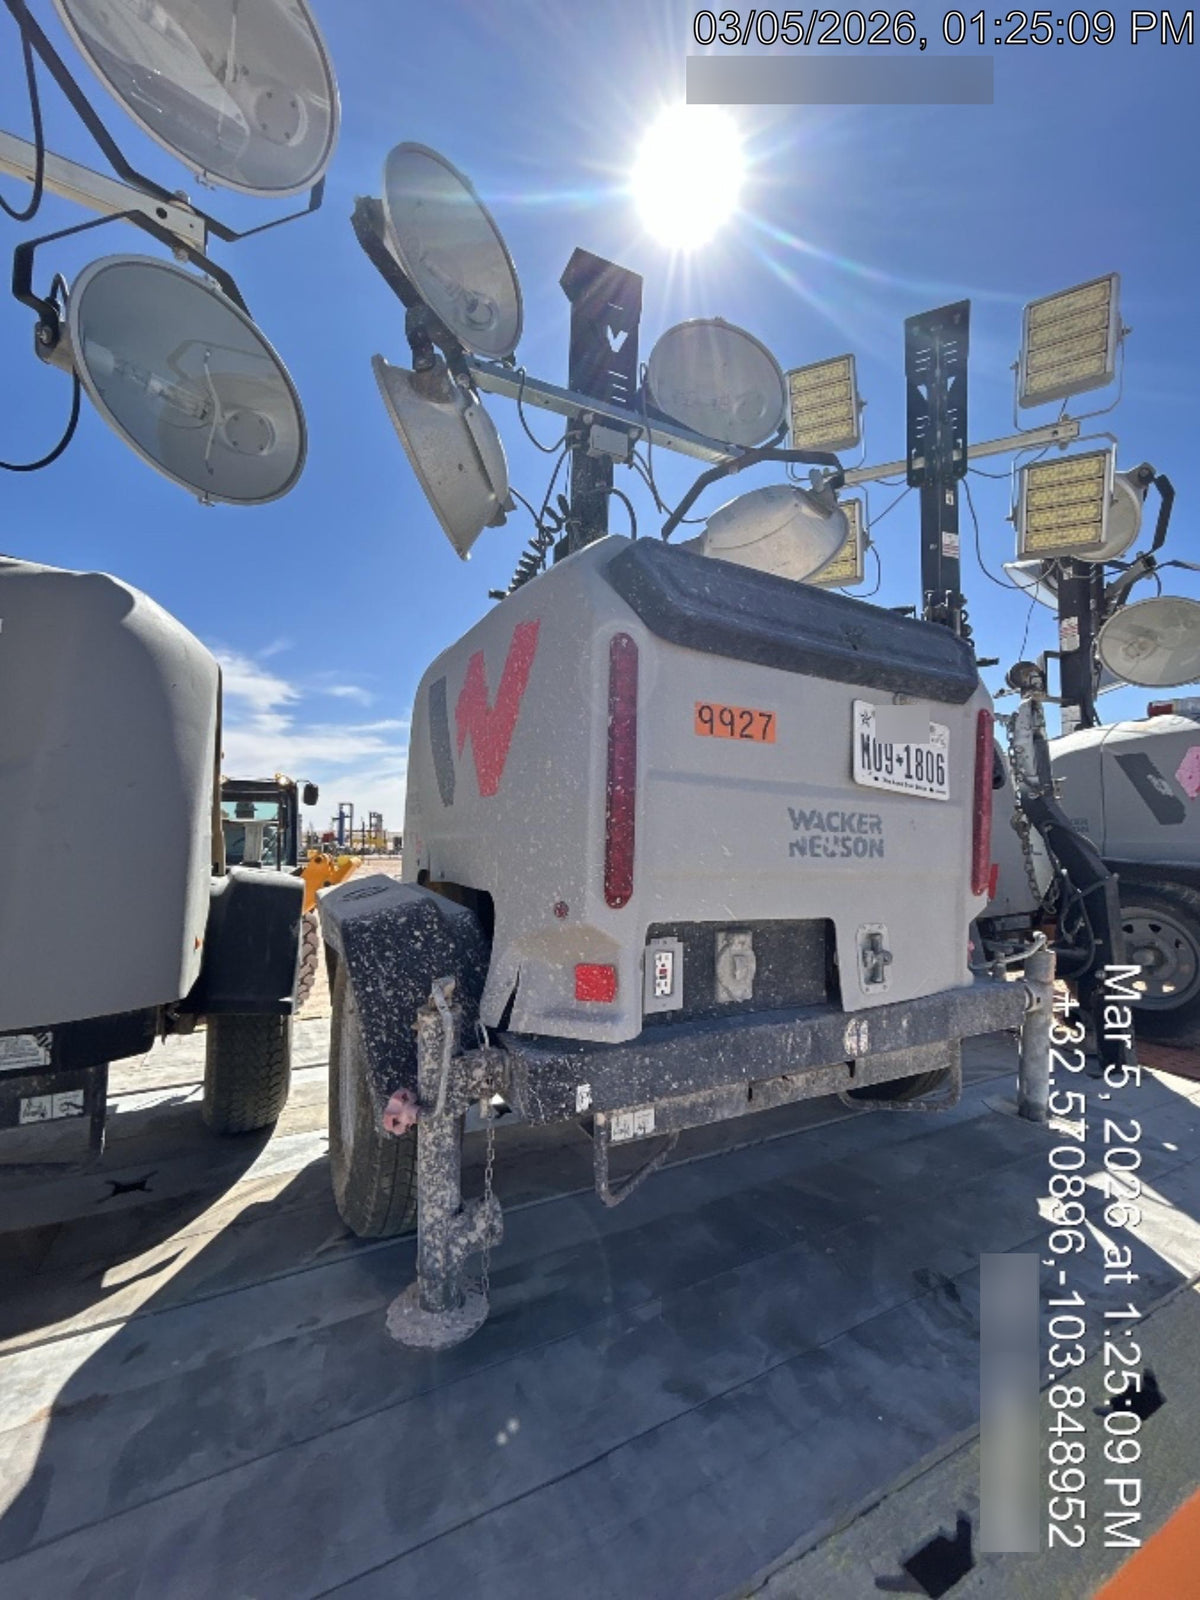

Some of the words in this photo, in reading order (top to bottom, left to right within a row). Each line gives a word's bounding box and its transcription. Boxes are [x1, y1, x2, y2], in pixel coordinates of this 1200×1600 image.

[698, 705, 773, 740] 9927
[904, 744, 946, 786] 1806
[787, 806, 883, 834] WACKER
